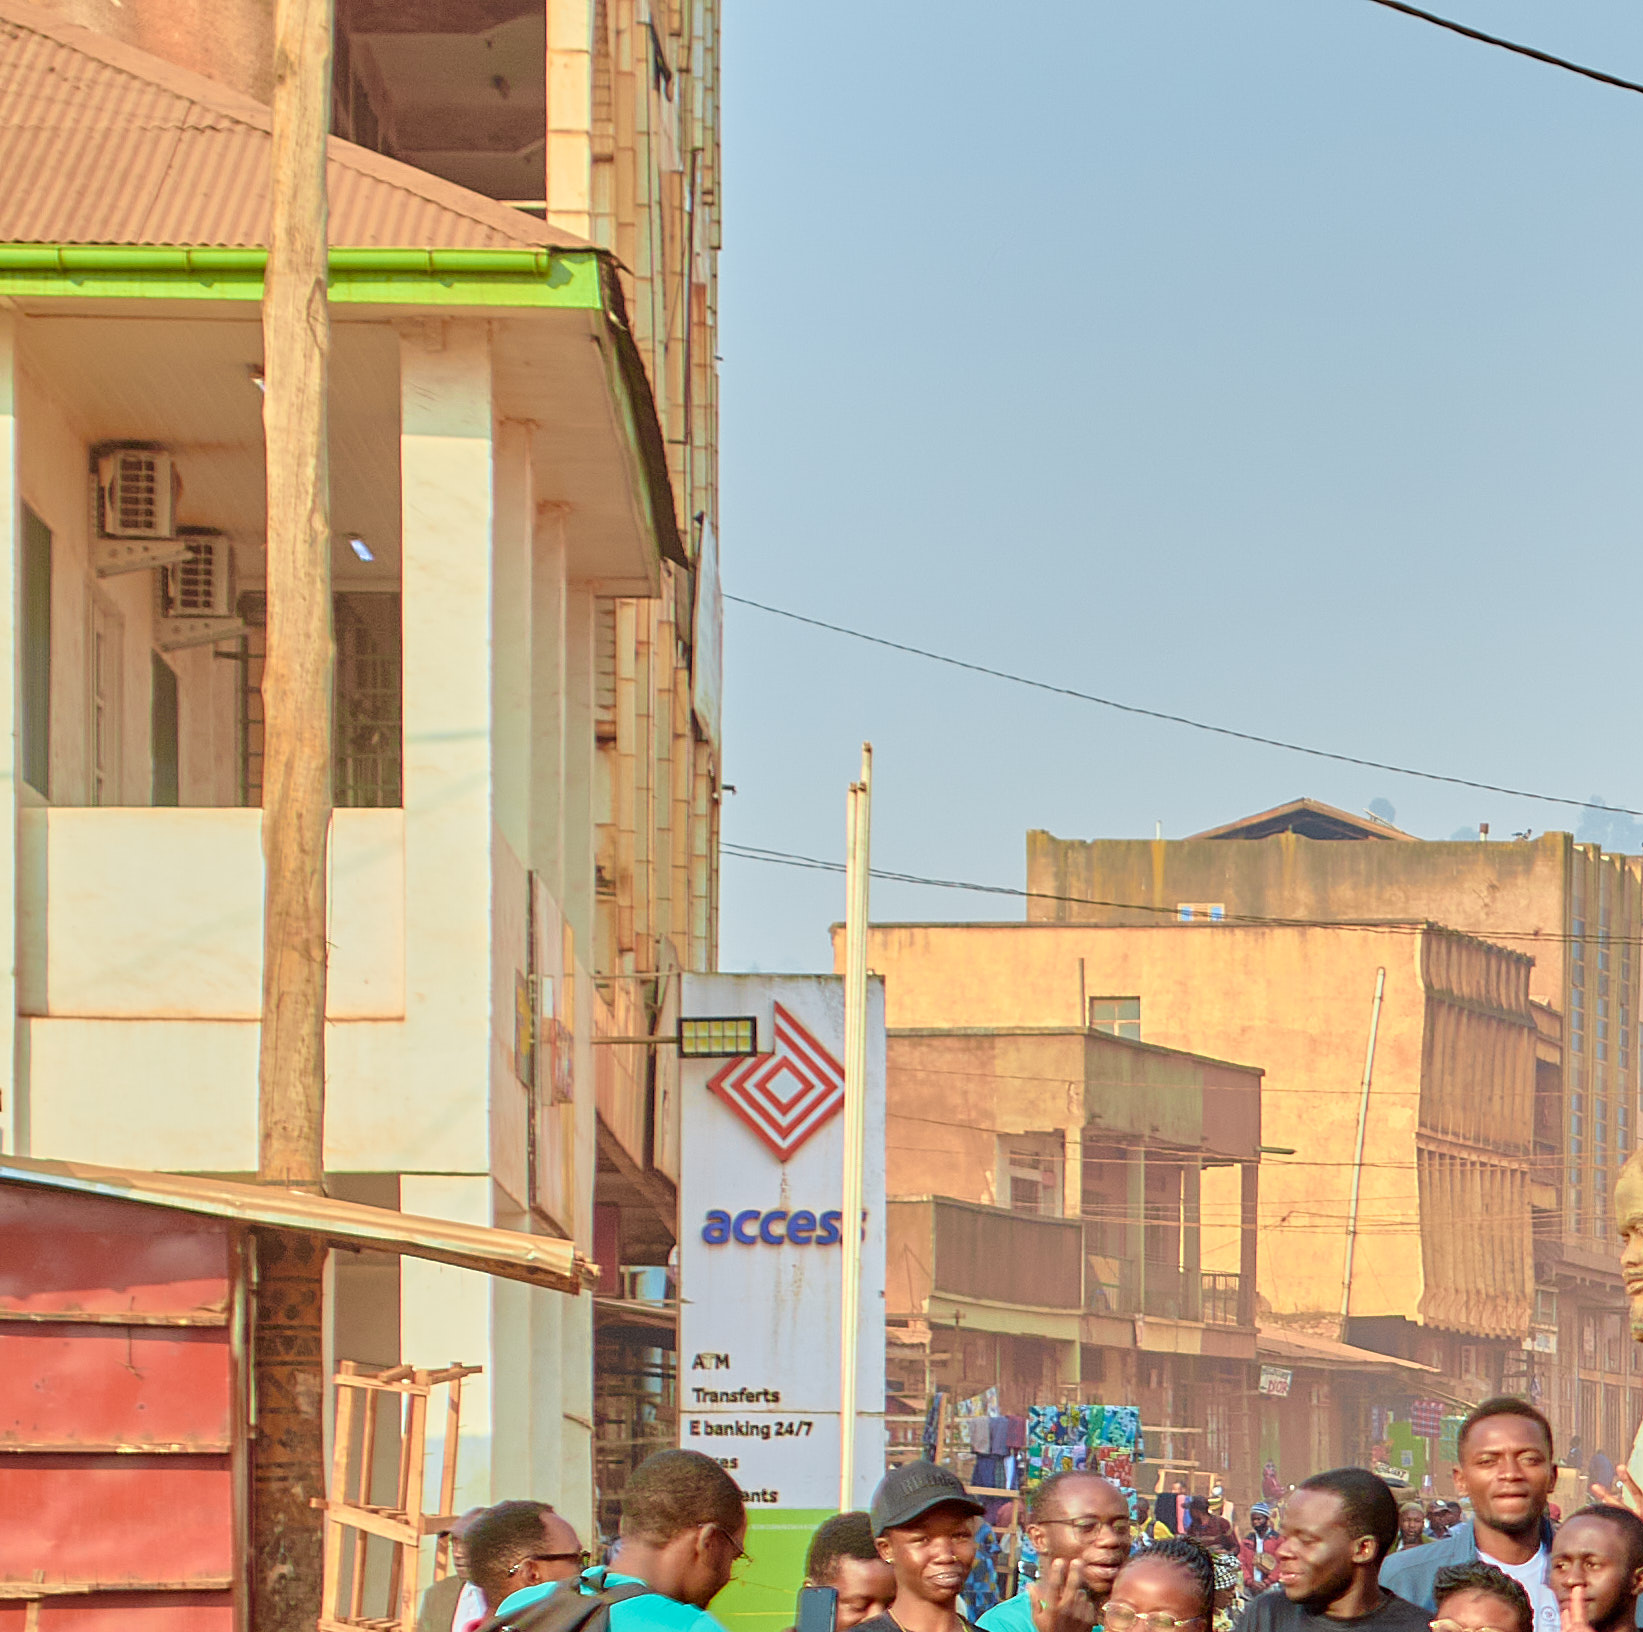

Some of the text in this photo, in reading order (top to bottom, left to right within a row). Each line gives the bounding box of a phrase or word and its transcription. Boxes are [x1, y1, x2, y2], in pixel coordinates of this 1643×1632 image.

[692, 1387, 780, 1403] Transferts
[690, 1420, 813, 1440] E banking 24/7
